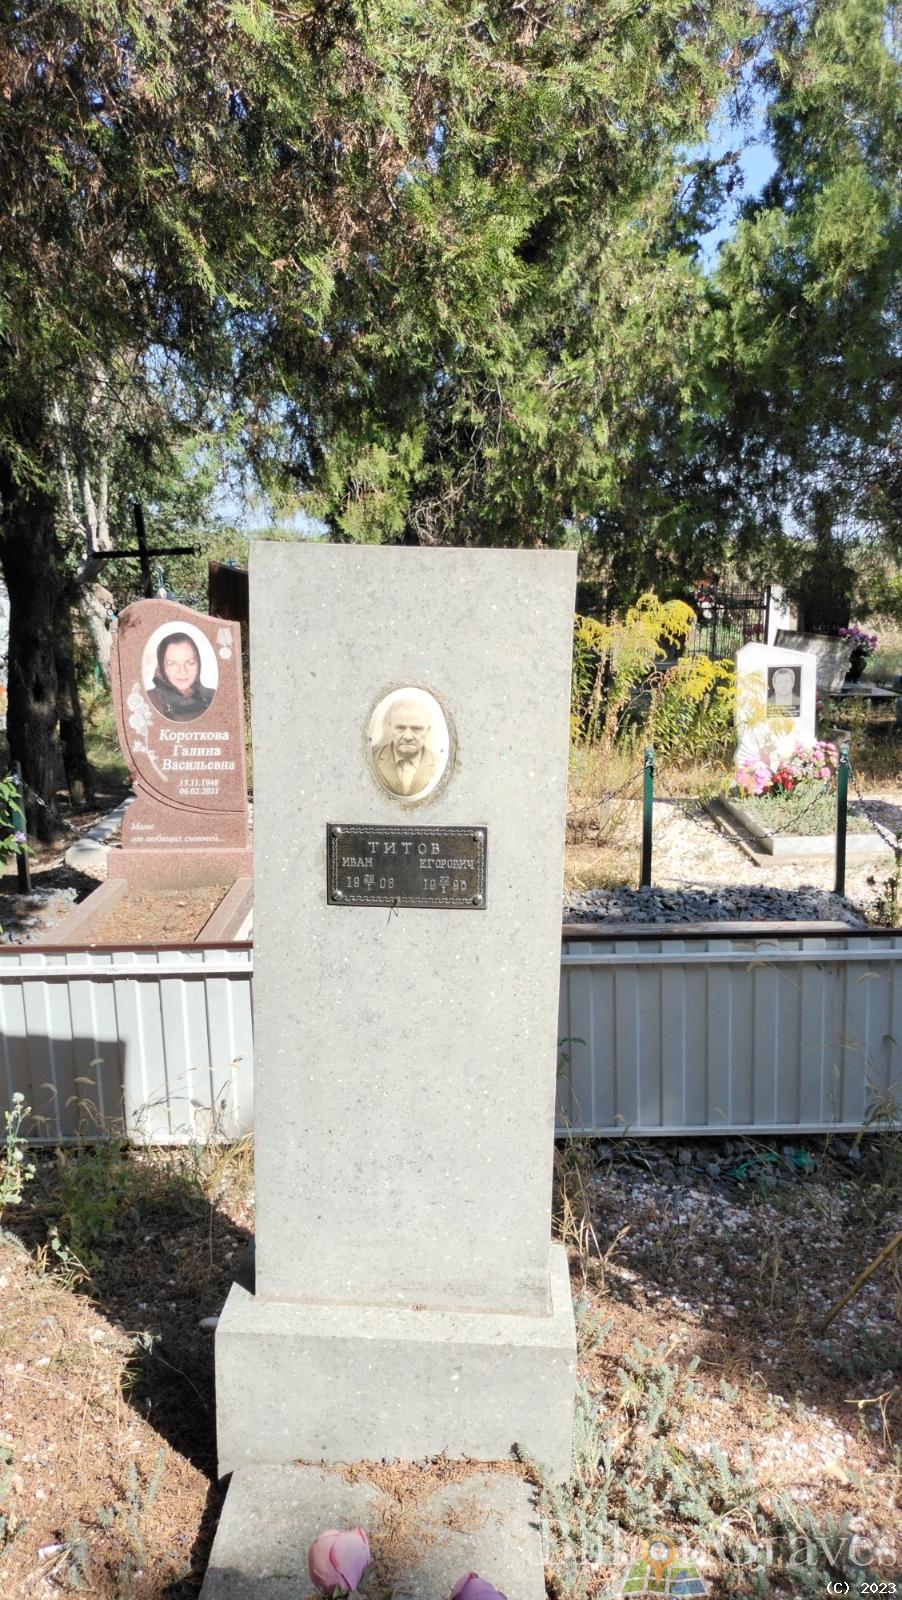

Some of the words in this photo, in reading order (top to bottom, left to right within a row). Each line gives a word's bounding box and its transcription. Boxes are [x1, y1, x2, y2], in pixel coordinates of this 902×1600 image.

[159, 728, 230, 744] Короткова
[172, 744, 221, 757] Галина
[161, 758, 236, 771] Васильевна
[367, 841, 441, 855] ТИТОВ
[342, 857, 373, 868] ИВАН
[420, 858, 475, 870] ЕГОРОВИЧ
